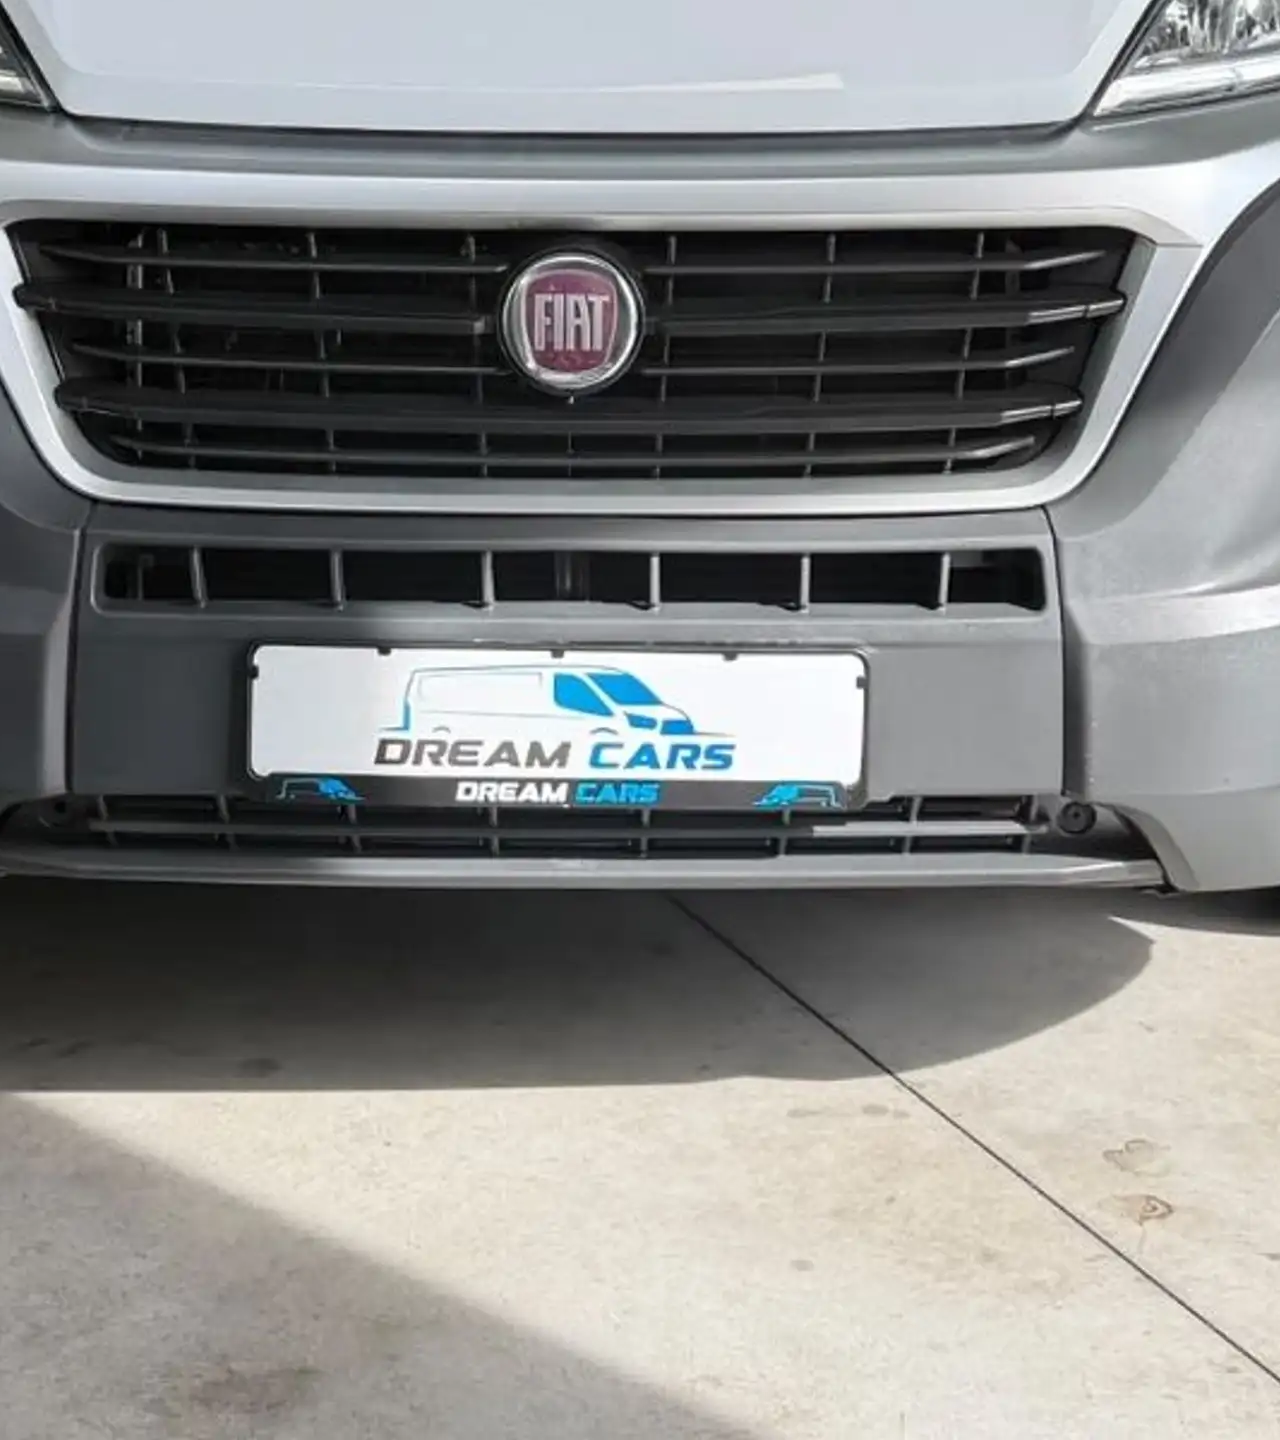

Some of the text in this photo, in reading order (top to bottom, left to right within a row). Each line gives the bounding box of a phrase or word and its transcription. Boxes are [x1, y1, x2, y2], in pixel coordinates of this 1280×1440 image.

[533, 293, 611, 352] FIAT
[374, 738, 737, 770] DREAM CARS
[455, 781, 661, 804] DREAM CARS
